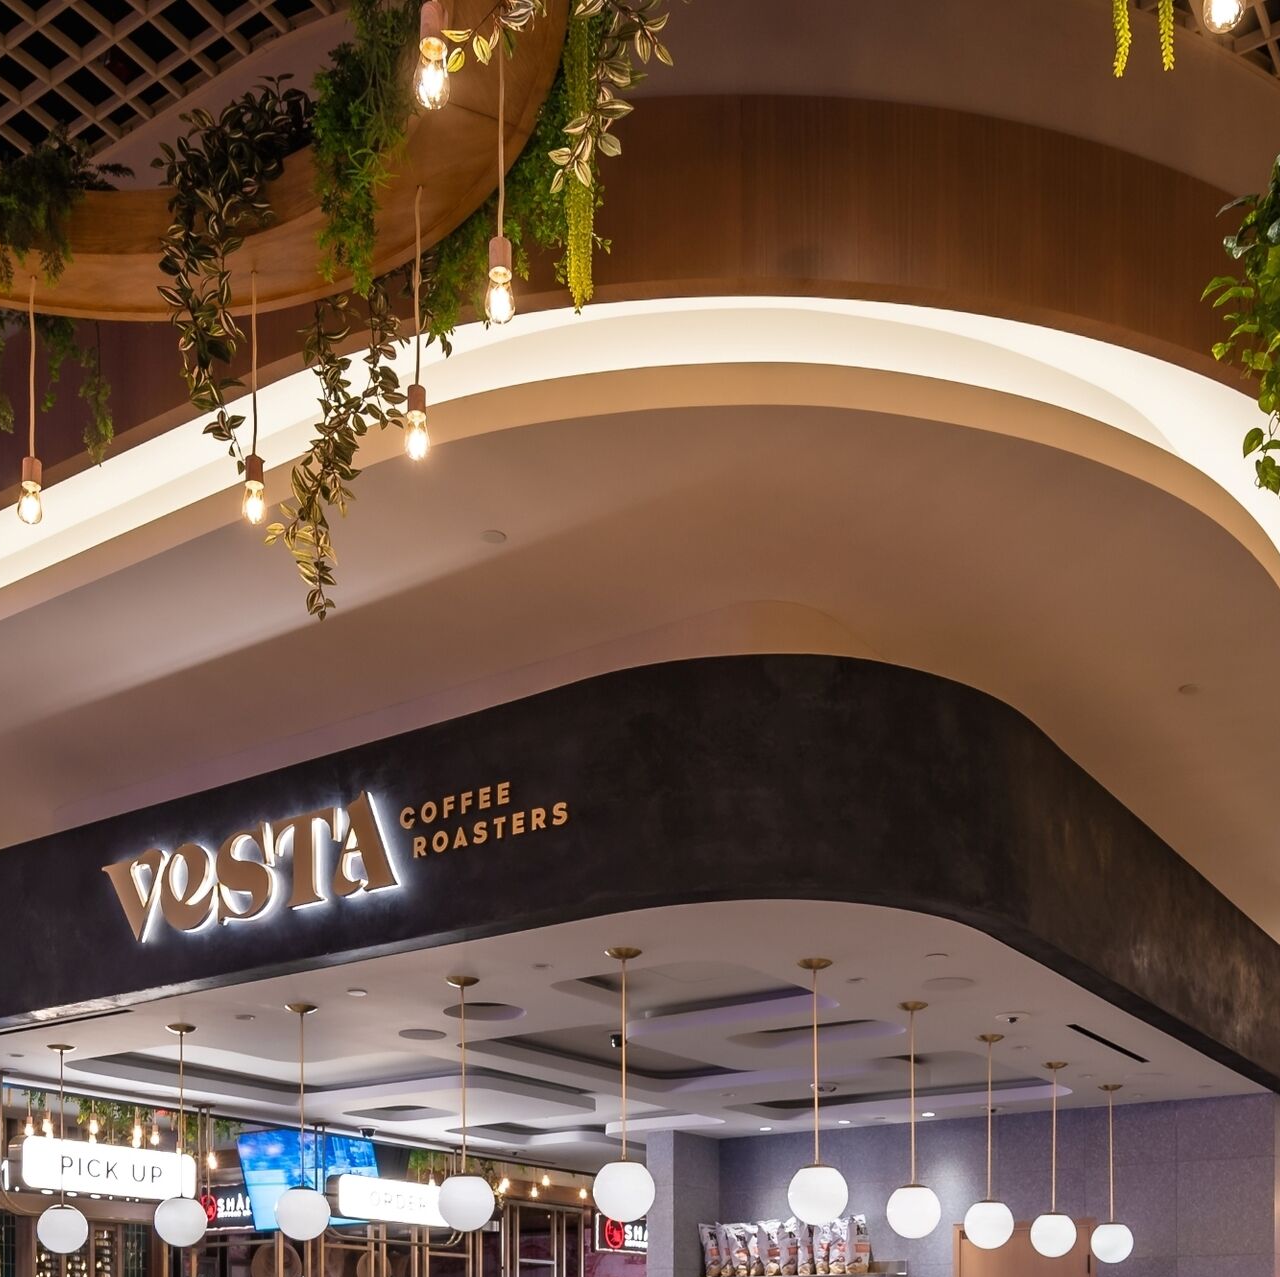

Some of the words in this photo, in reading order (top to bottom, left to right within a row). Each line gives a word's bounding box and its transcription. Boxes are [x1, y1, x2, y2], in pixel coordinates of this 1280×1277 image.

[399, 781, 512, 830] COFFEE
[413, 801, 569, 858] ROASTERS
[61, 1155, 118, 1180] PICK
[132, 1163, 162, 1183] UP
